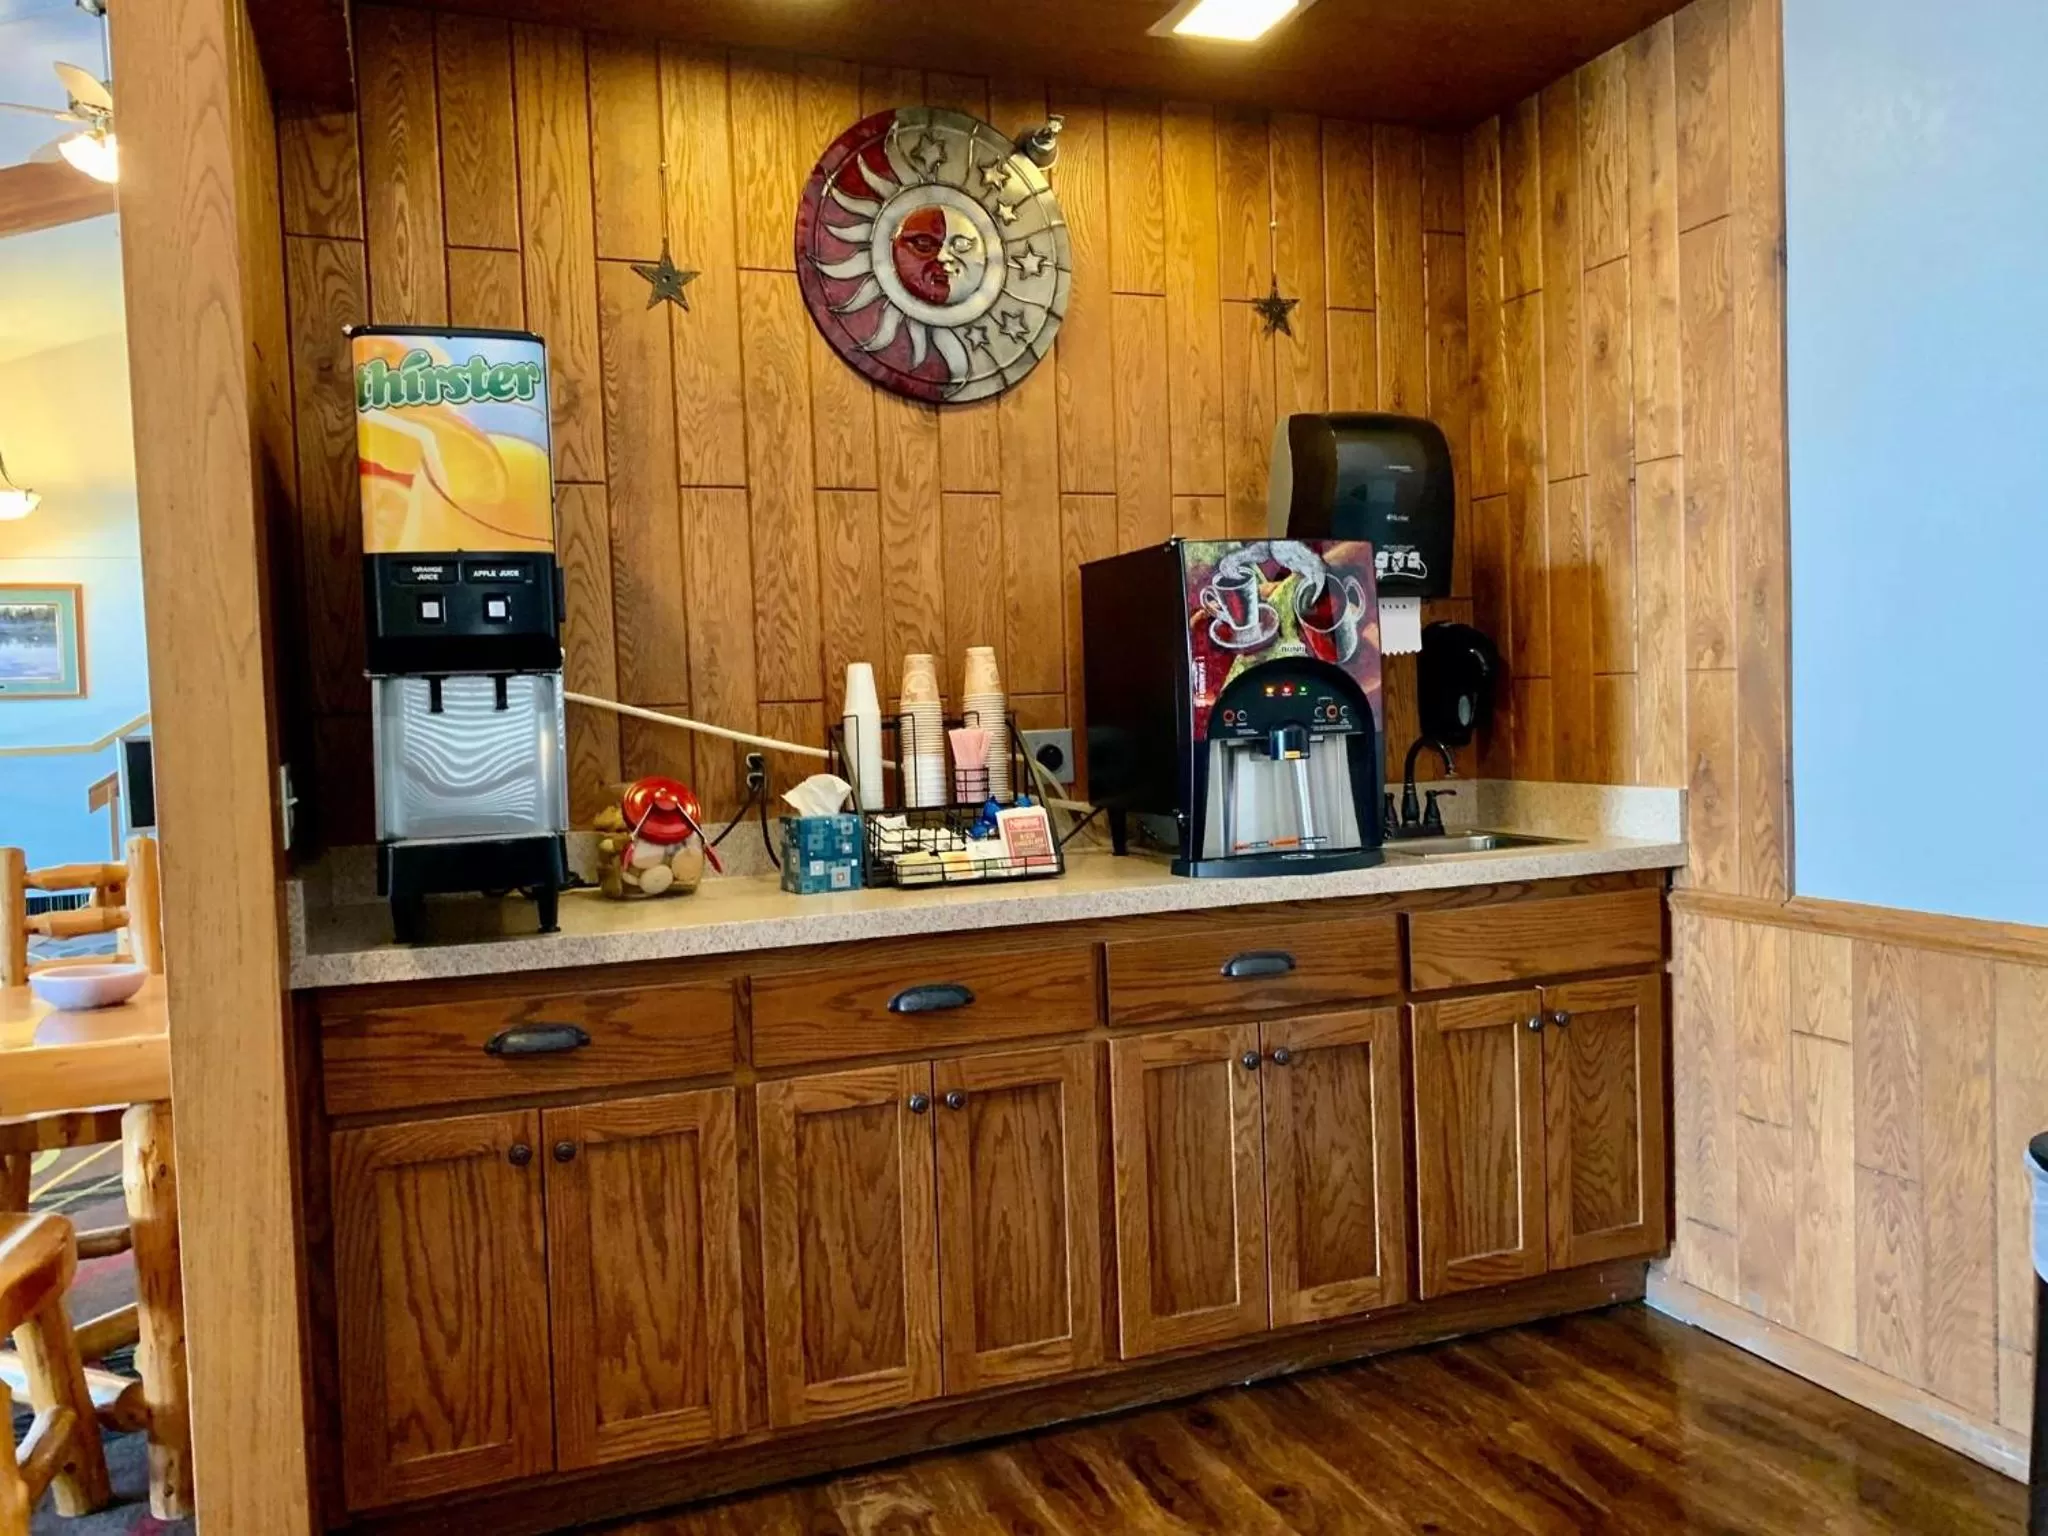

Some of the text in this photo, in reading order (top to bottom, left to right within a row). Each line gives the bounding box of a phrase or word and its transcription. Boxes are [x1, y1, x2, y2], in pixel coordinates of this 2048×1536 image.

[356, 350, 542, 411] thirster
[411, 565, 443, 573] ORANGE
[473, 569, 520, 577] APPLE JUICE
[416, 573, 439, 581] JUICE
